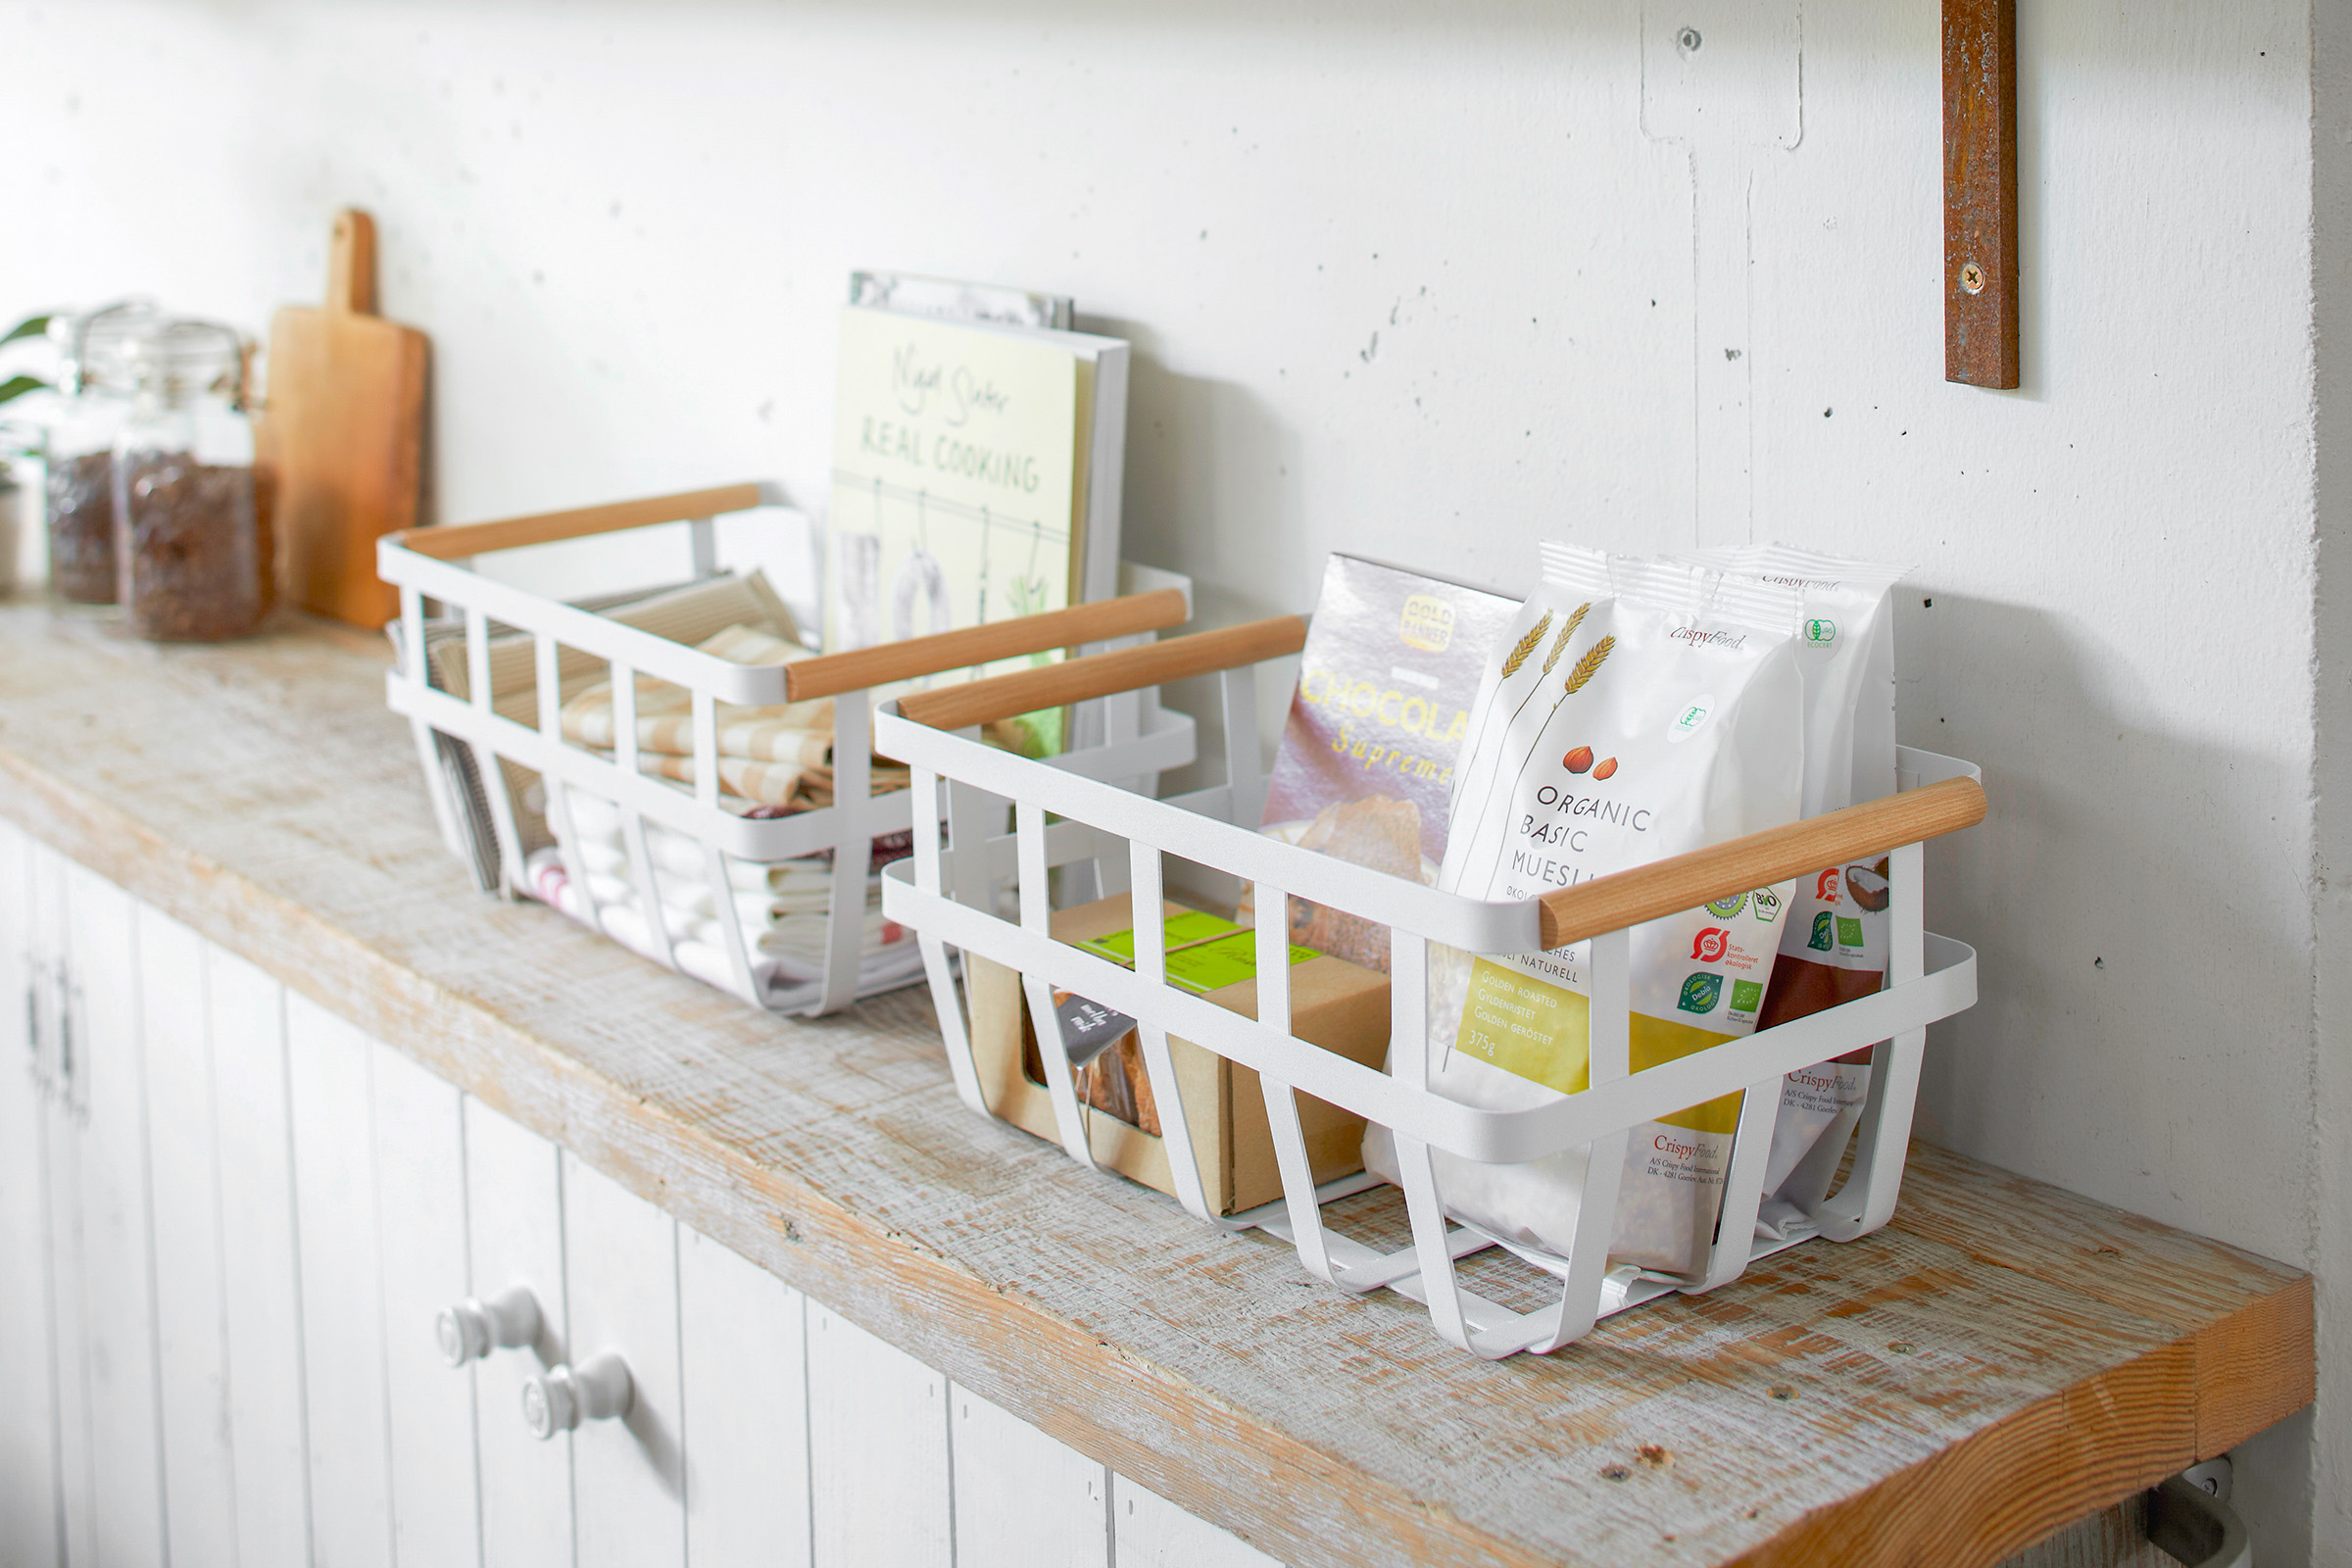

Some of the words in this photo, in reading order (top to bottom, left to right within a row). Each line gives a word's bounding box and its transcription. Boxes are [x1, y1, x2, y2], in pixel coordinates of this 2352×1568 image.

[860, 415, 924, 466] REAL
[934, 433, 1041, 495] COOKING
[1331, 725, 1453, 785] Supreme
[1537, 785, 1650, 832] ORGANIC
[1520, 814, 1588, 853] BASIC
[1520, 955, 1578, 983] NATURELL
[1727, 952, 1758, 963] kontrolleret
[1482, 970, 1515, 993] GOLDEN
[1518, 988, 1557, 1008] ROASTED
[1691, 986, 1711, 1001] Debio
[1474, 1005, 1508, 1028] GOLDEN
[1469, 1030, 1495, 1056] 375g
[1784, 1099, 1795, 1107] DK
[1798, 1092, 1818, 1102] Crispy
[1819, 1095, 1832, 1104] Food
[1647, 1166, 1659, 1176] DK
[1662, 1159, 1679, 1170] Crispy
[1680, 1163, 1693, 1172] Food
